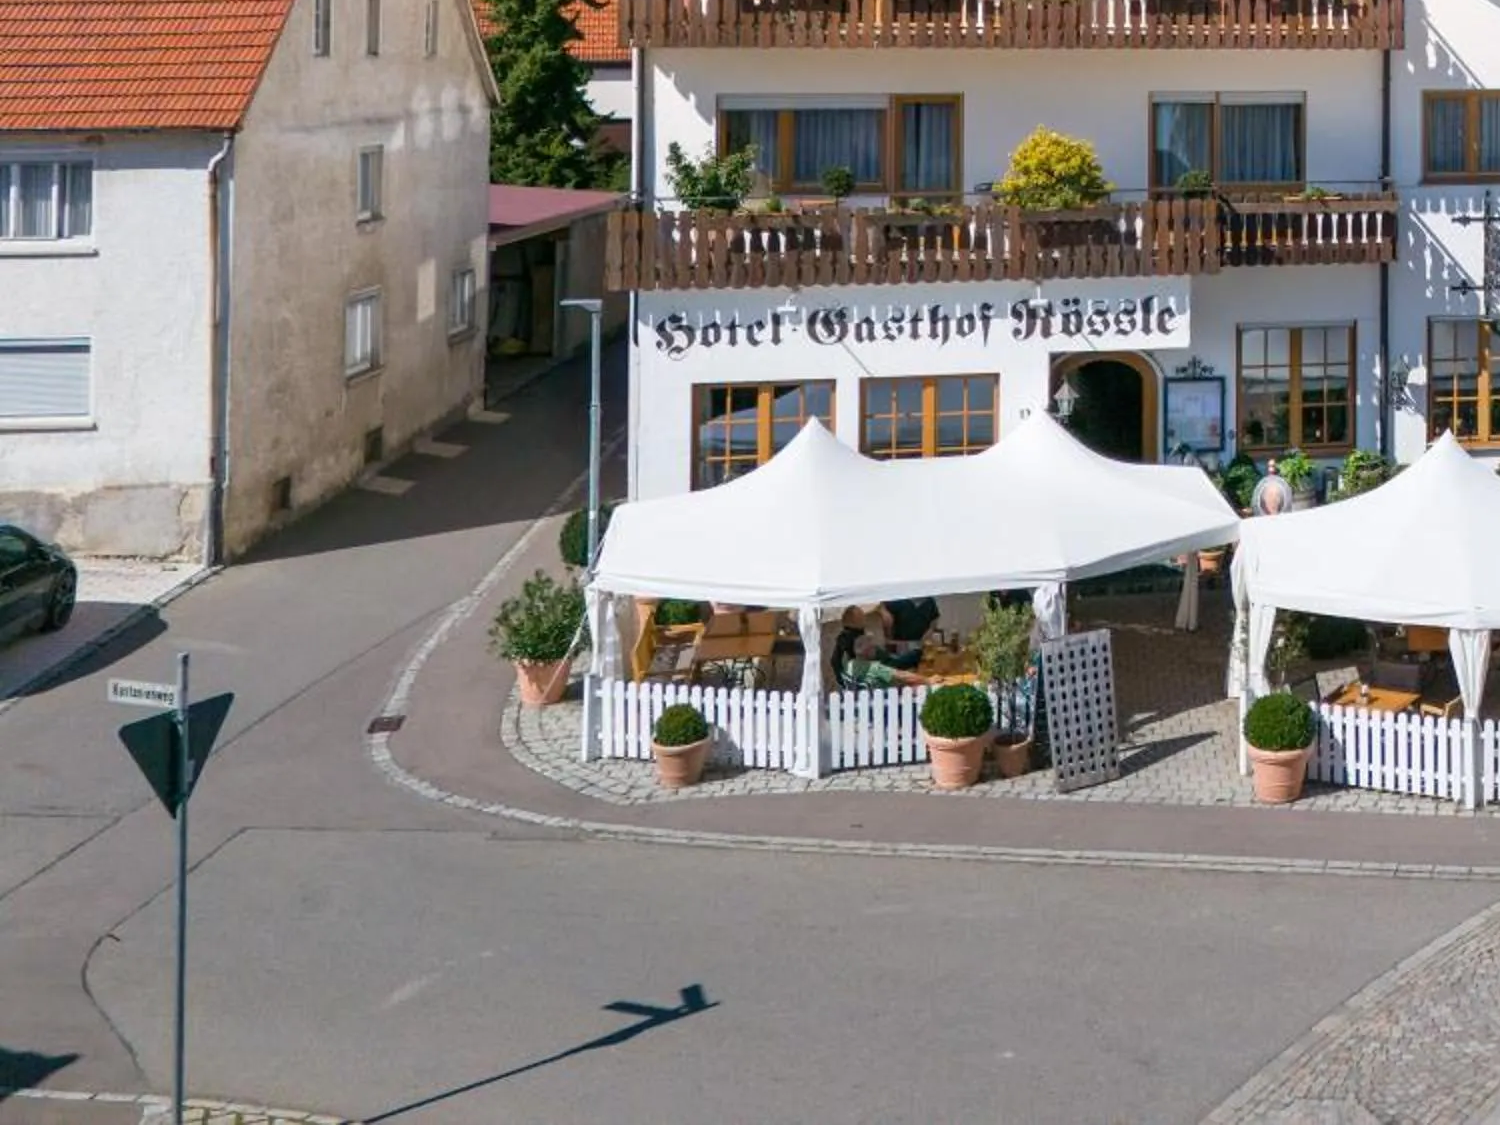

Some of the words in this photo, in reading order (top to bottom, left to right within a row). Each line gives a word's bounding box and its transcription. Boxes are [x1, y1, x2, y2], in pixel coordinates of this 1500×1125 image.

[655, 311, 782, 362] Hotel
[806, 302, 996, 348] Gasthof
[1010, 294, 1178, 340] Rössle
